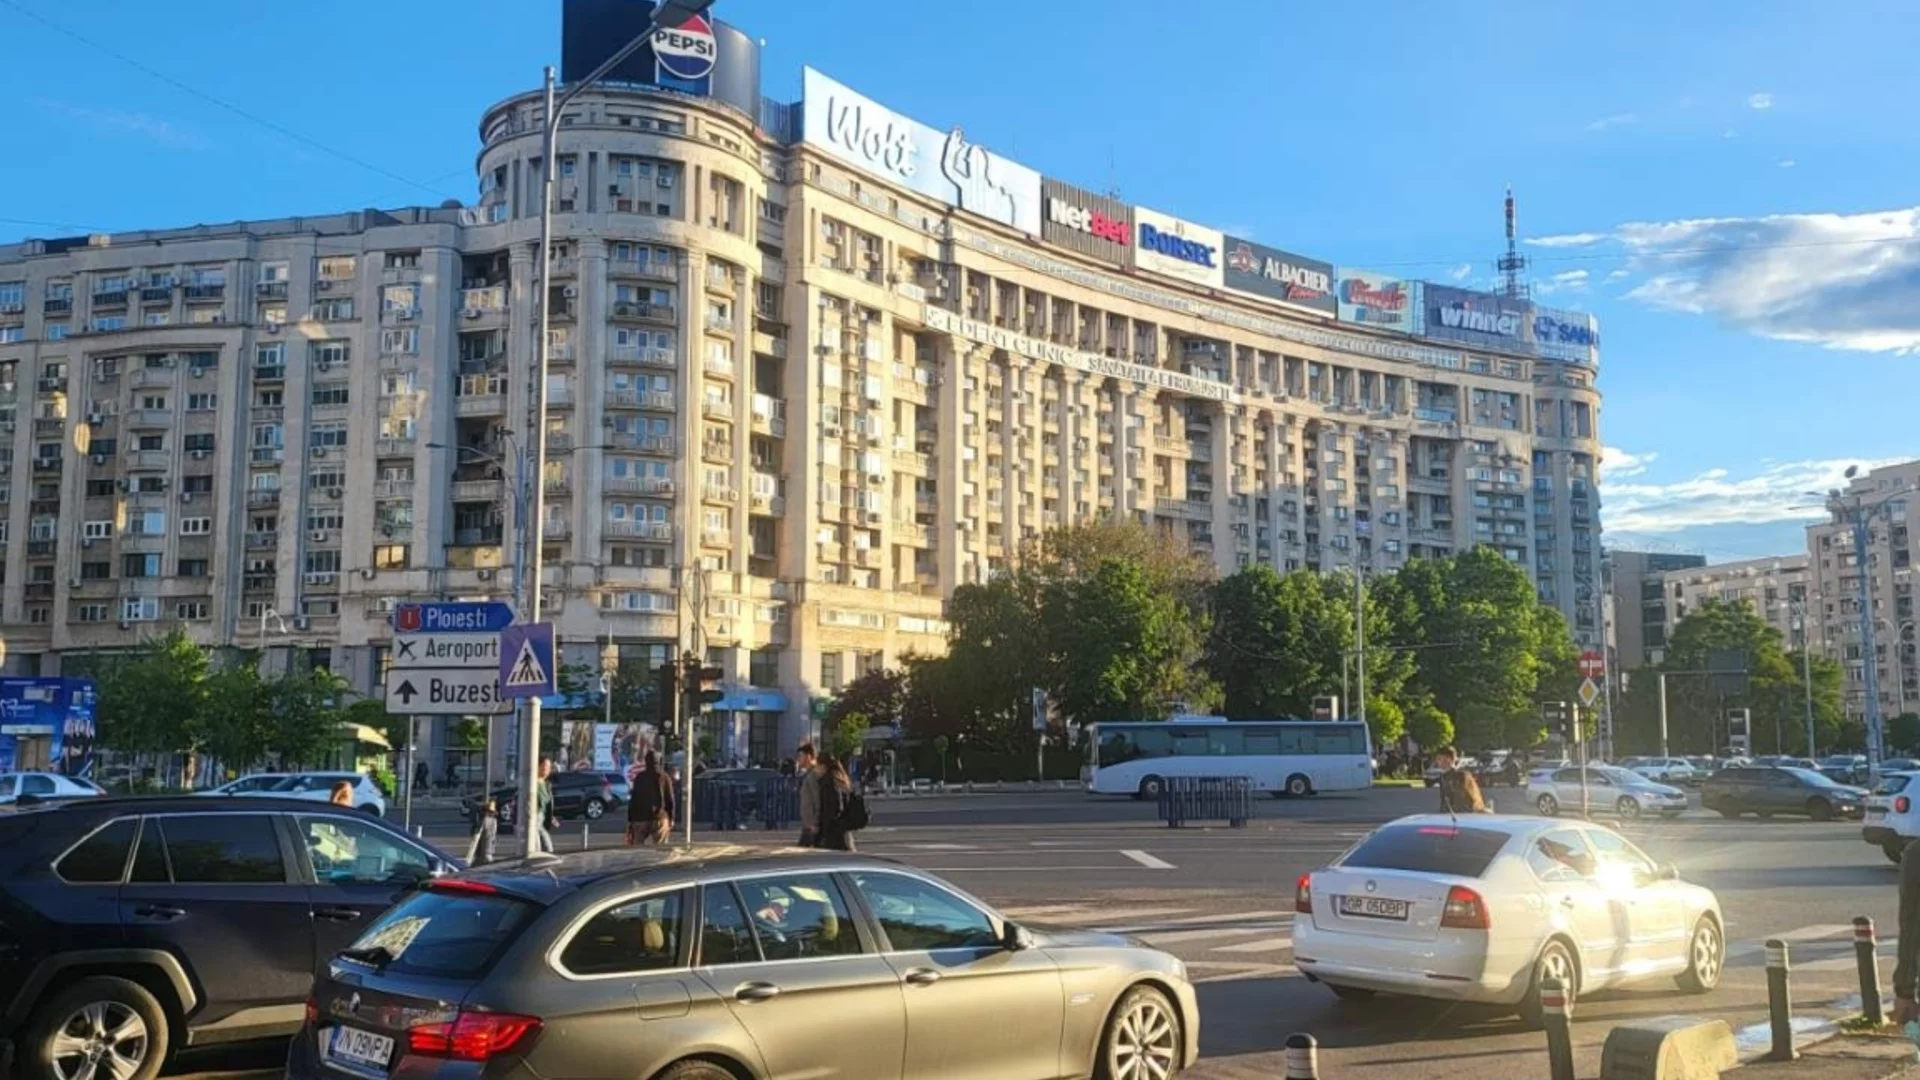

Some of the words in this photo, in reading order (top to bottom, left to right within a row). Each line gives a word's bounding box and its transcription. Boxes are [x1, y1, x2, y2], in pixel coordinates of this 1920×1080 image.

[655, 31, 713, 56] PEPSI
[827, 96, 918, 177] Wolt
[1050, 197, 1131, 246] NetBet
[1441, 301, 1518, 335] winner
[426, 637, 498, 663] Aeroport
[430, 678, 506, 703] Buzest
